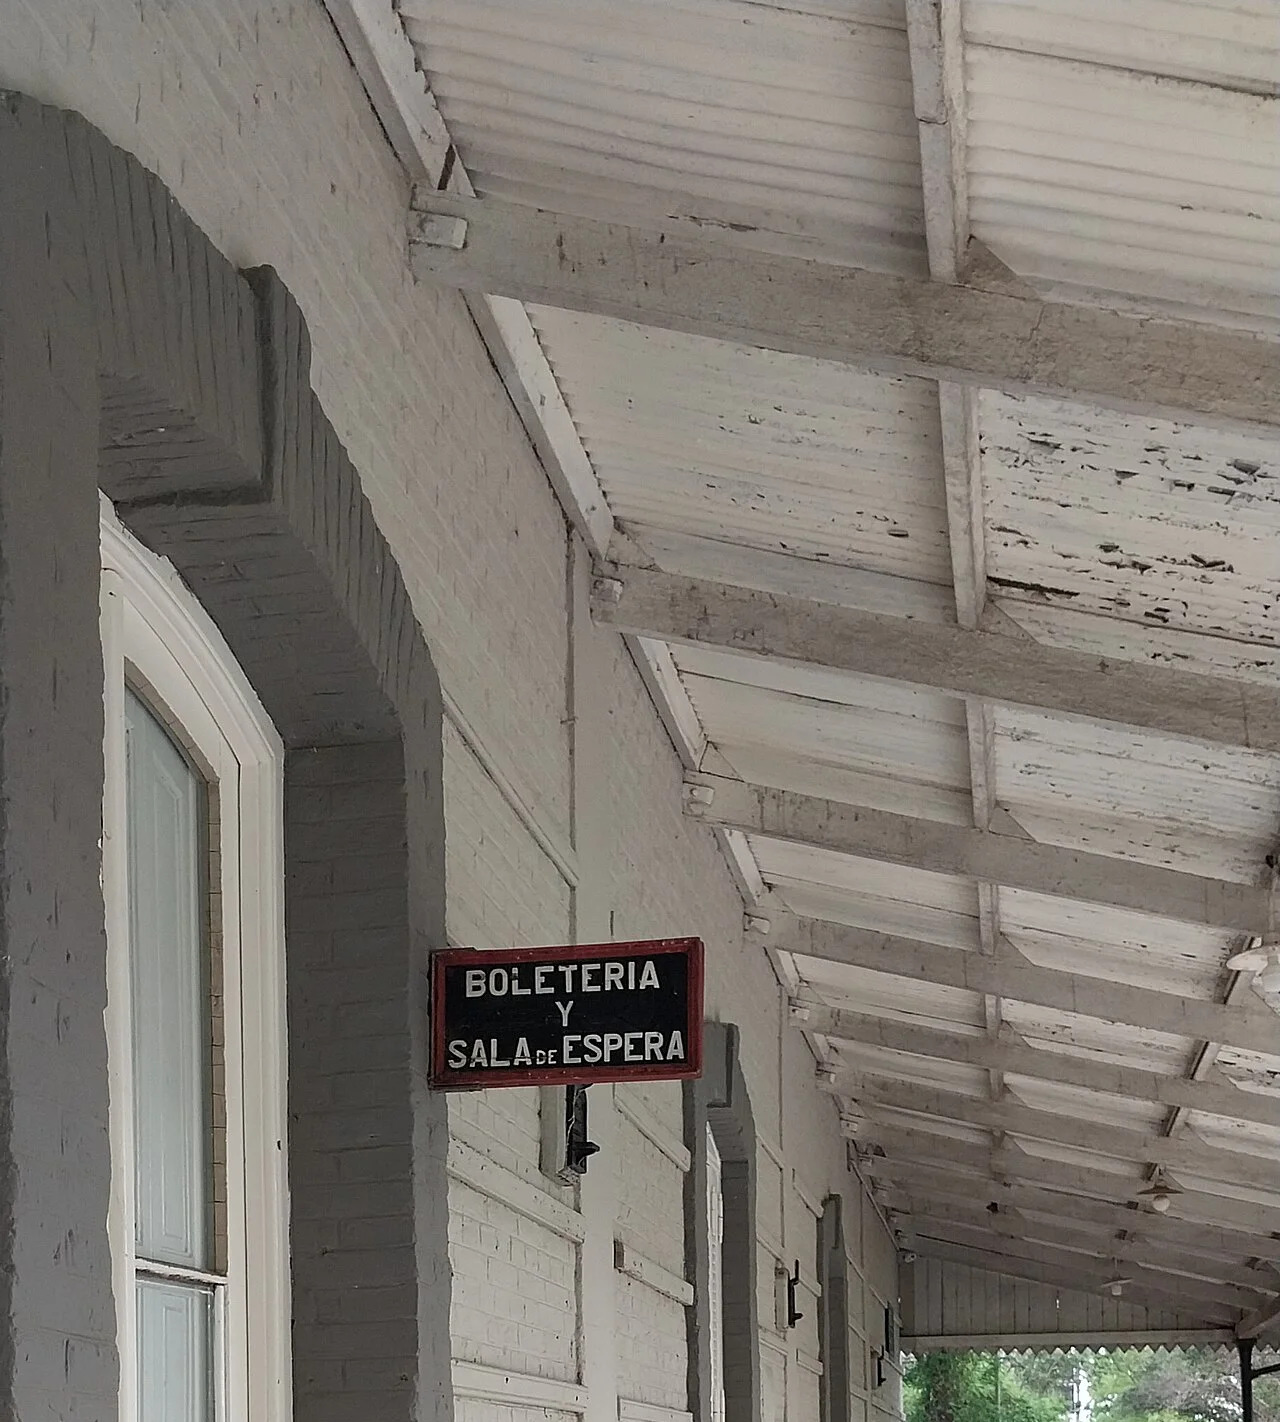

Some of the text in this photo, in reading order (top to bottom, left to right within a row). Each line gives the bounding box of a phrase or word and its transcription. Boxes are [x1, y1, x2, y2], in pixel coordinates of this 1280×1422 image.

[465, 960, 660, 998] BOLETERIA
[554, 1000, 574, 1027] Y
[448, 1030, 685, 1069] SALA DE ESPERA
